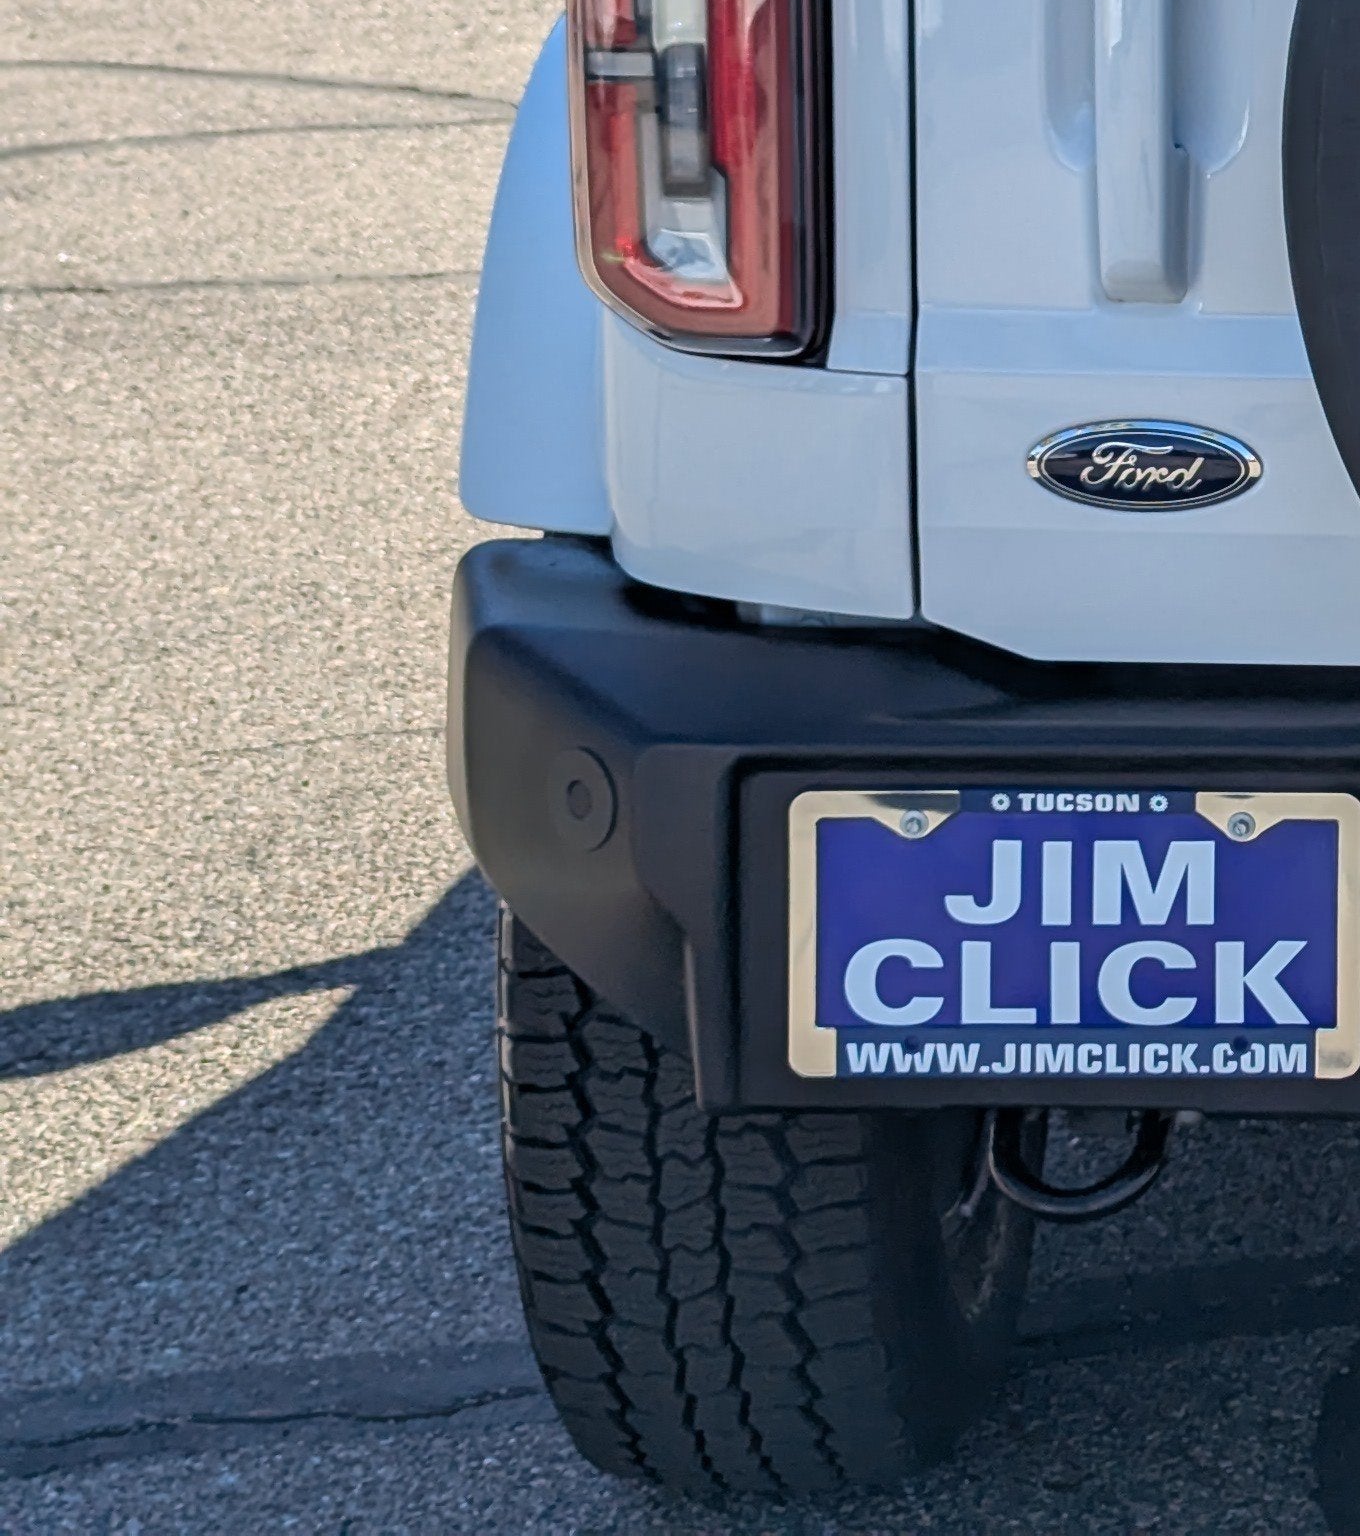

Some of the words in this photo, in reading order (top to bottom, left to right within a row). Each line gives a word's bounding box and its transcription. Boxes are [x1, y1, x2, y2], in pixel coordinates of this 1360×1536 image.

[1080, 441, 1205, 492] Ford
[1017, 792, 1140, 813] TUCSON
[943, 839, 1216, 926] JIM
[843, 938, 1311, 1026] CLICK
[845, 1041, 1308, 1076] WWW.JIMCLICK.COM
